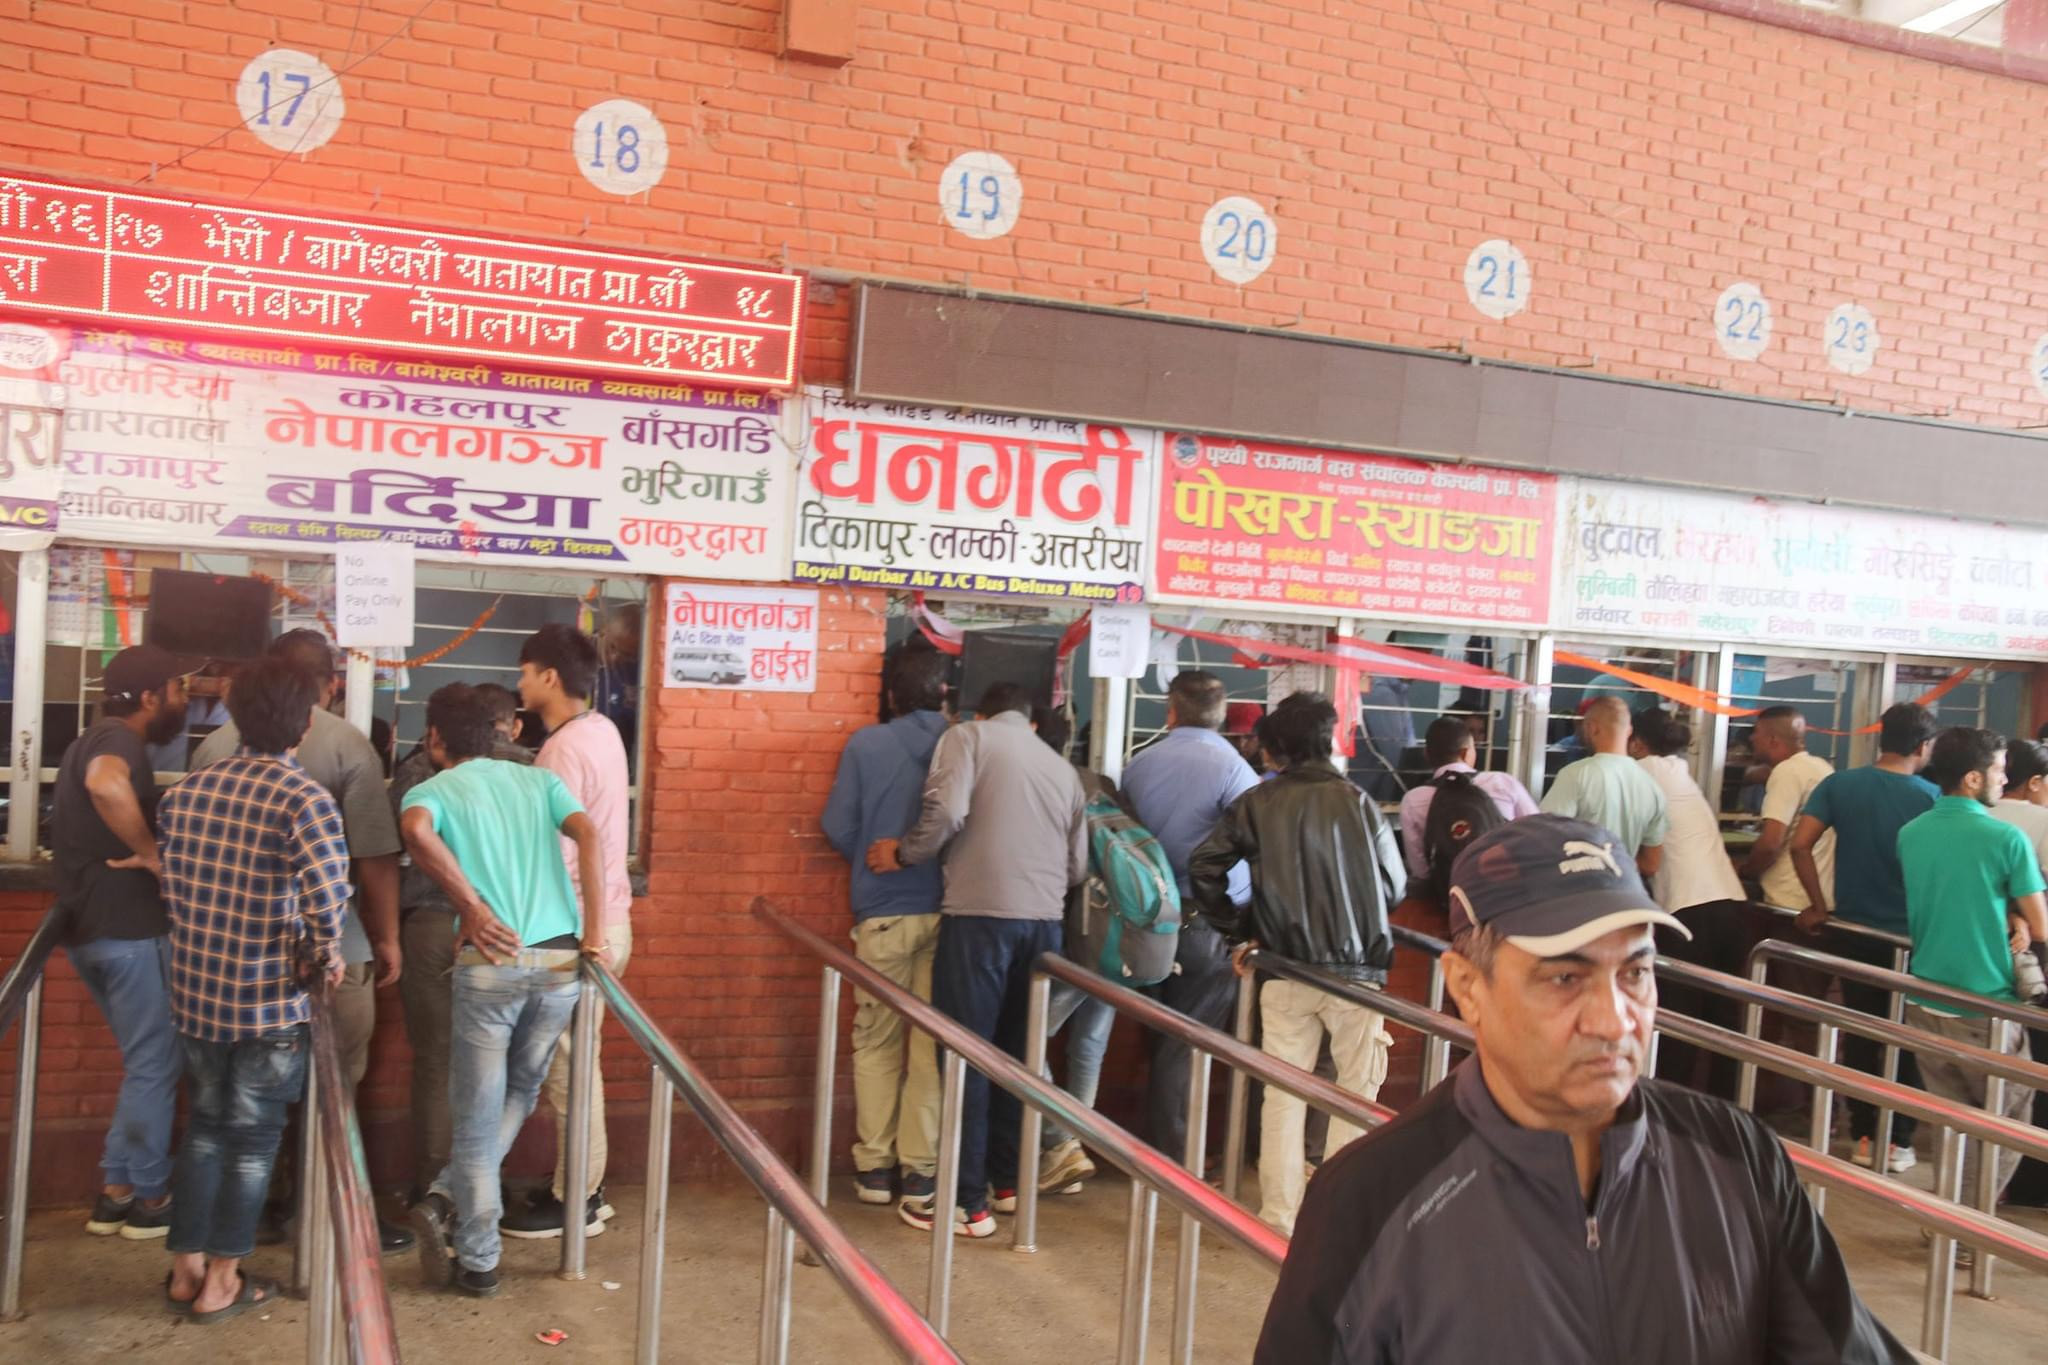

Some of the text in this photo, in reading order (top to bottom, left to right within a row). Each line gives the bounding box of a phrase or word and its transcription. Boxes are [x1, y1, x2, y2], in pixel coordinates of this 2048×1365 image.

[256, 70, 311, 127] 17
[590, 120, 641, 173] 18
[955, 171, 1000, 221] 19
[1216, 211, 1266, 262] 20
[454, 251, 595, 299] यातायात
[736, 286, 773, 319] १८
[1477, 255, 1516, 299] 21
[1725, 297, 1764, 342] 22
[1833, 316, 1868, 353] 23
[338, 384, 571, 428] कोहलपुर
[62, 450, 228, 490] राजापुर
[808, 416, 1143, 527] धनगढी
[1327, 459, 1355, 479] बस
[344, 555, 364, 567] No
[344, 575, 390, 587] Online
[794, 561, 1143, 604] Royal Durbar Air A/C Bus Deluxe Metro 19
[345, 594, 403, 609] Pay Only
[345, 614, 379, 626] Cash
